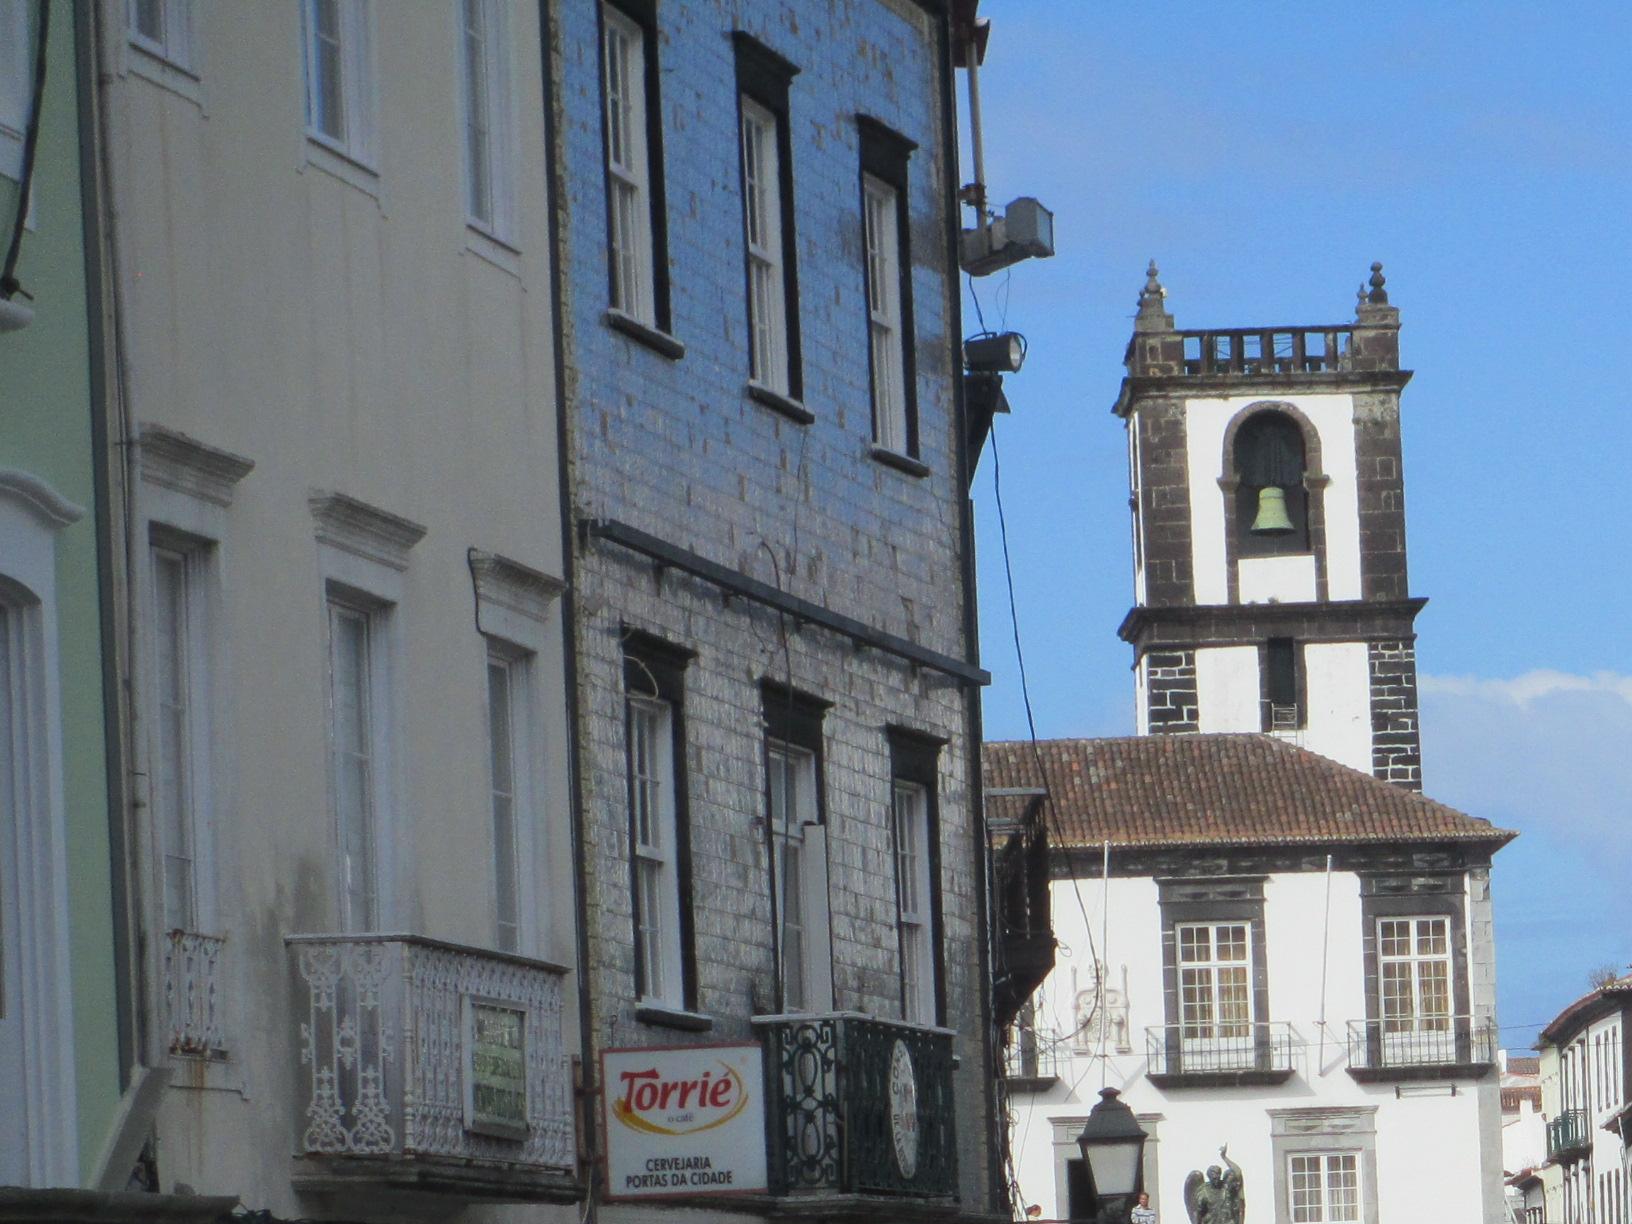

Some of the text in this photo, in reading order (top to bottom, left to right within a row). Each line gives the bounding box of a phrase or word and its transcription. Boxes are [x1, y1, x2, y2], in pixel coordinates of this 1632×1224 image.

[620, 1067, 732, 1114] Torrié
[646, 1157, 712, 1172] CERVEJARIA
[626, 1171, 733, 1188] PORTAS DA CIDADE
